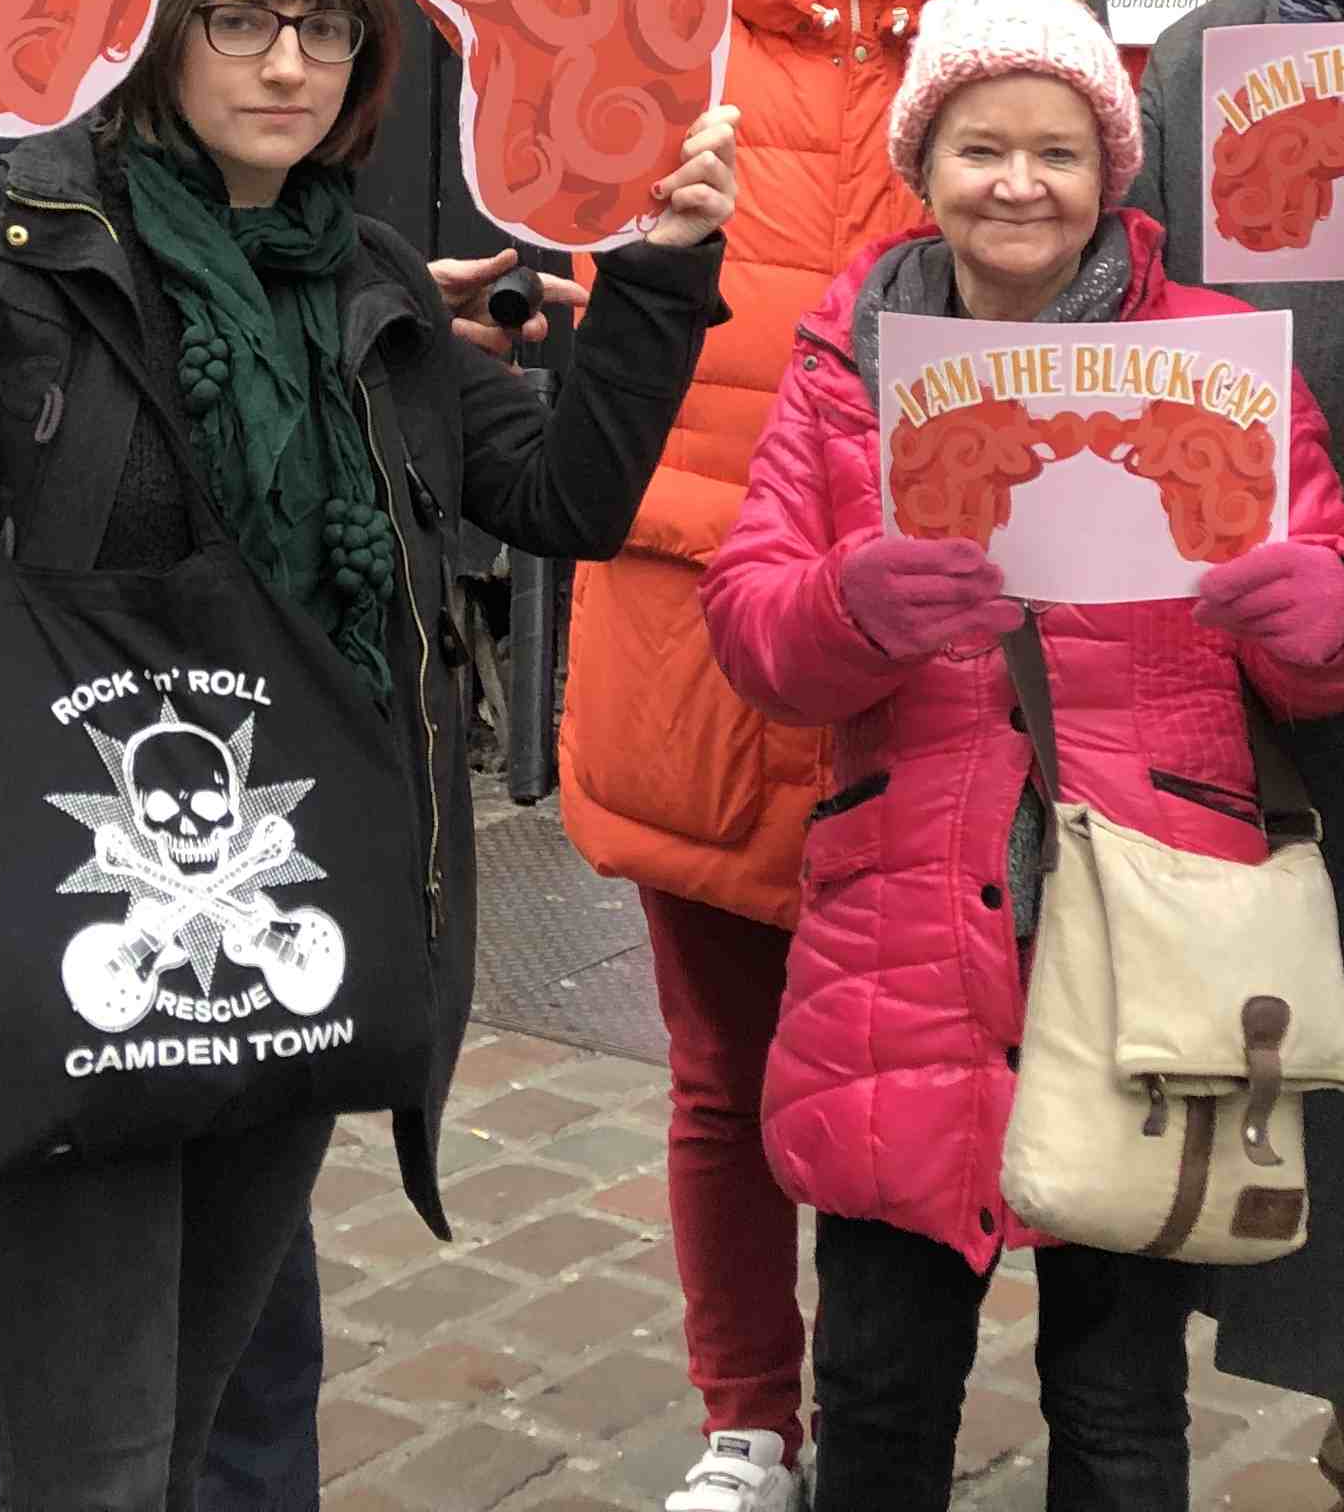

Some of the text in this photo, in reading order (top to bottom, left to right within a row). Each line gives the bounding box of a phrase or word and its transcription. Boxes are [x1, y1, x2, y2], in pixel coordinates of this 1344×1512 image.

[1217, 92, 1247, 129] I
[1251, 60, 1302, 117] AM
[895, 347, 1278, 427] I AM THE BLACK CAP
[51, 669, 140, 725] ROCK
[188, 669, 272, 706] ROLL
[156, 984, 273, 1024] RESCUE
[64, 1018, 355, 1078] CAMDEN TOWN
